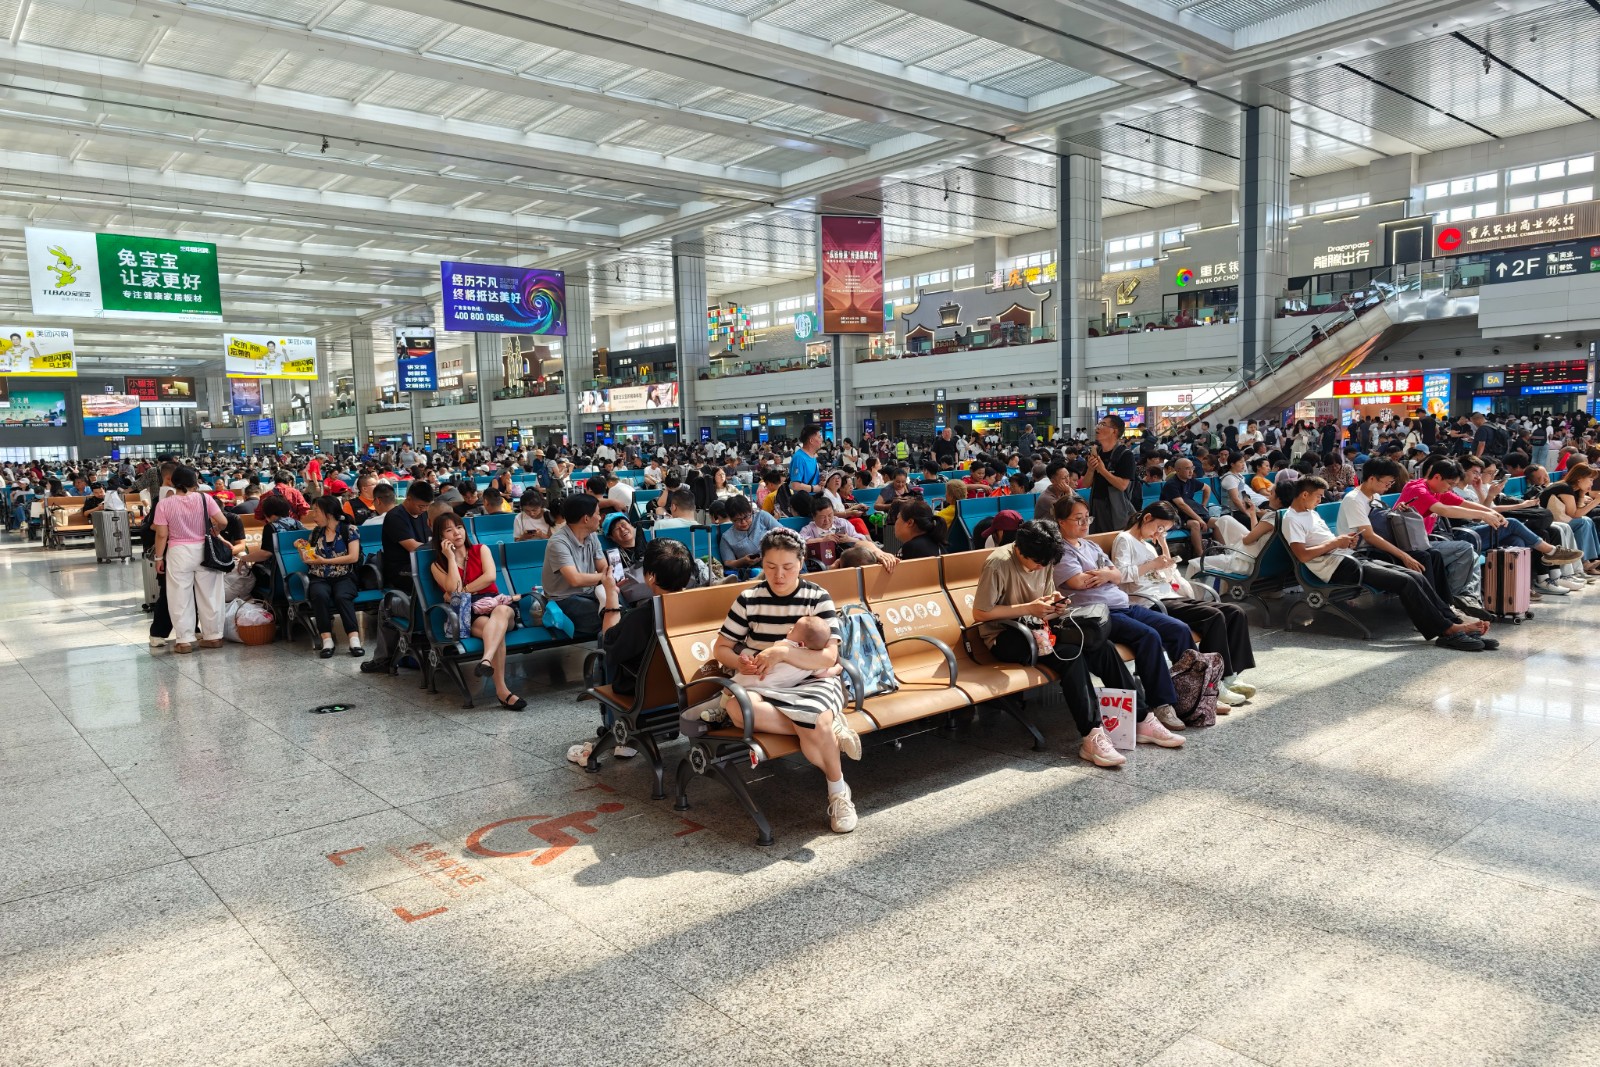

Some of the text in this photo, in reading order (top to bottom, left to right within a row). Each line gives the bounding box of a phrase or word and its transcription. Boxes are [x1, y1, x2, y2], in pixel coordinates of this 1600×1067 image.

[1467, 236, 1500, 245] CHONGQING
[1520, 228, 1557, 237] COMMERCIAL
[1327, 241, 1370, 253] Dragonpass
[117, 248, 179, 270] 兔宝宝
[1511, 258, 1541, 277] 2F
[119, 269, 202, 290] 让家更好
[452, 273, 498, 289] 经历不凡
[122, 290, 203, 303] 专注健康家居板材
[452, 288, 522, 305] 终将抵达美好
[454, 311, 505, 322] 400 800 0585
[36, 330, 69, 338] 美团闪购
[49, 361, 71, 369] 马上到
[1349, 379, 1410, 394] 绝味鸭脖
[1487, 375, 1500, 384] 5A
[1100, 696, 1133, 713] OVE
